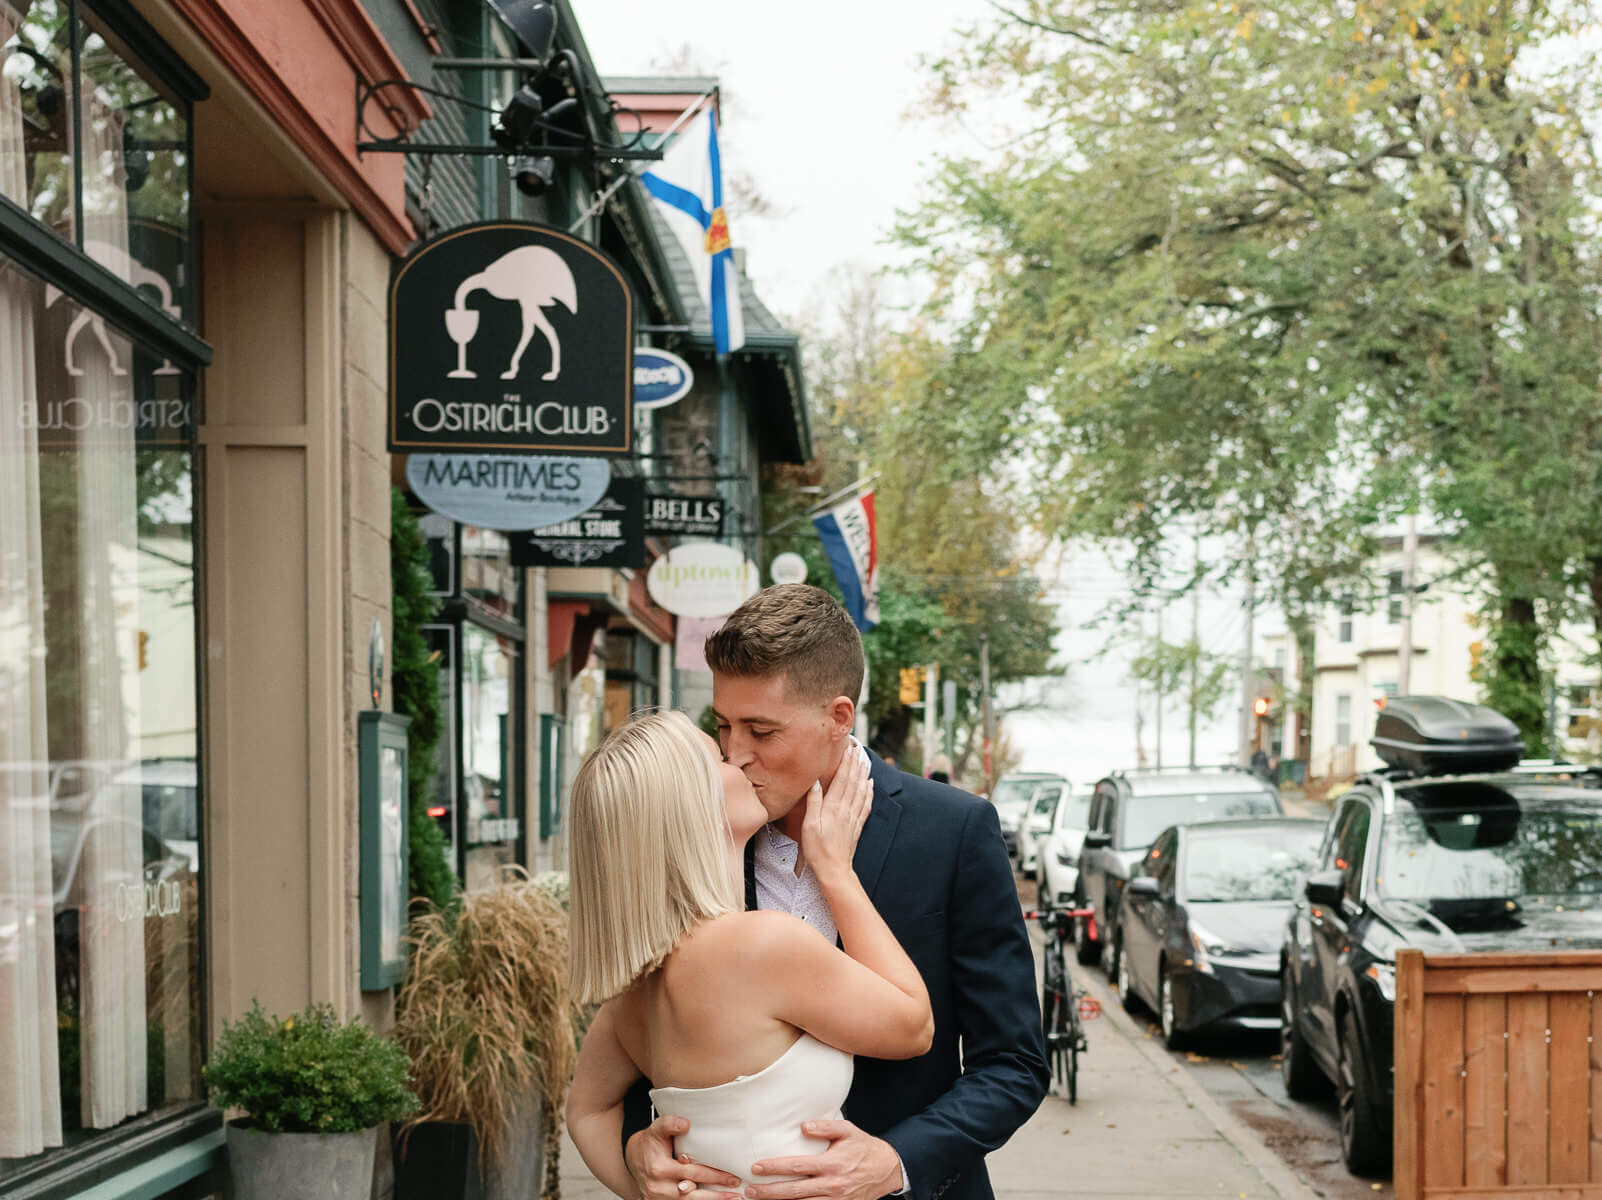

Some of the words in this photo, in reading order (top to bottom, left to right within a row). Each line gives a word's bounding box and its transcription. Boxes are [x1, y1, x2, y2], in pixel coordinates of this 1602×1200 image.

[503, 393, 521, 403] THE
[534, 401, 610, 435] CLUB
[424, 459, 582, 491] MARITIMES
[584, 519, 622, 538] STORE
[656, 563, 749, 588] uptown
